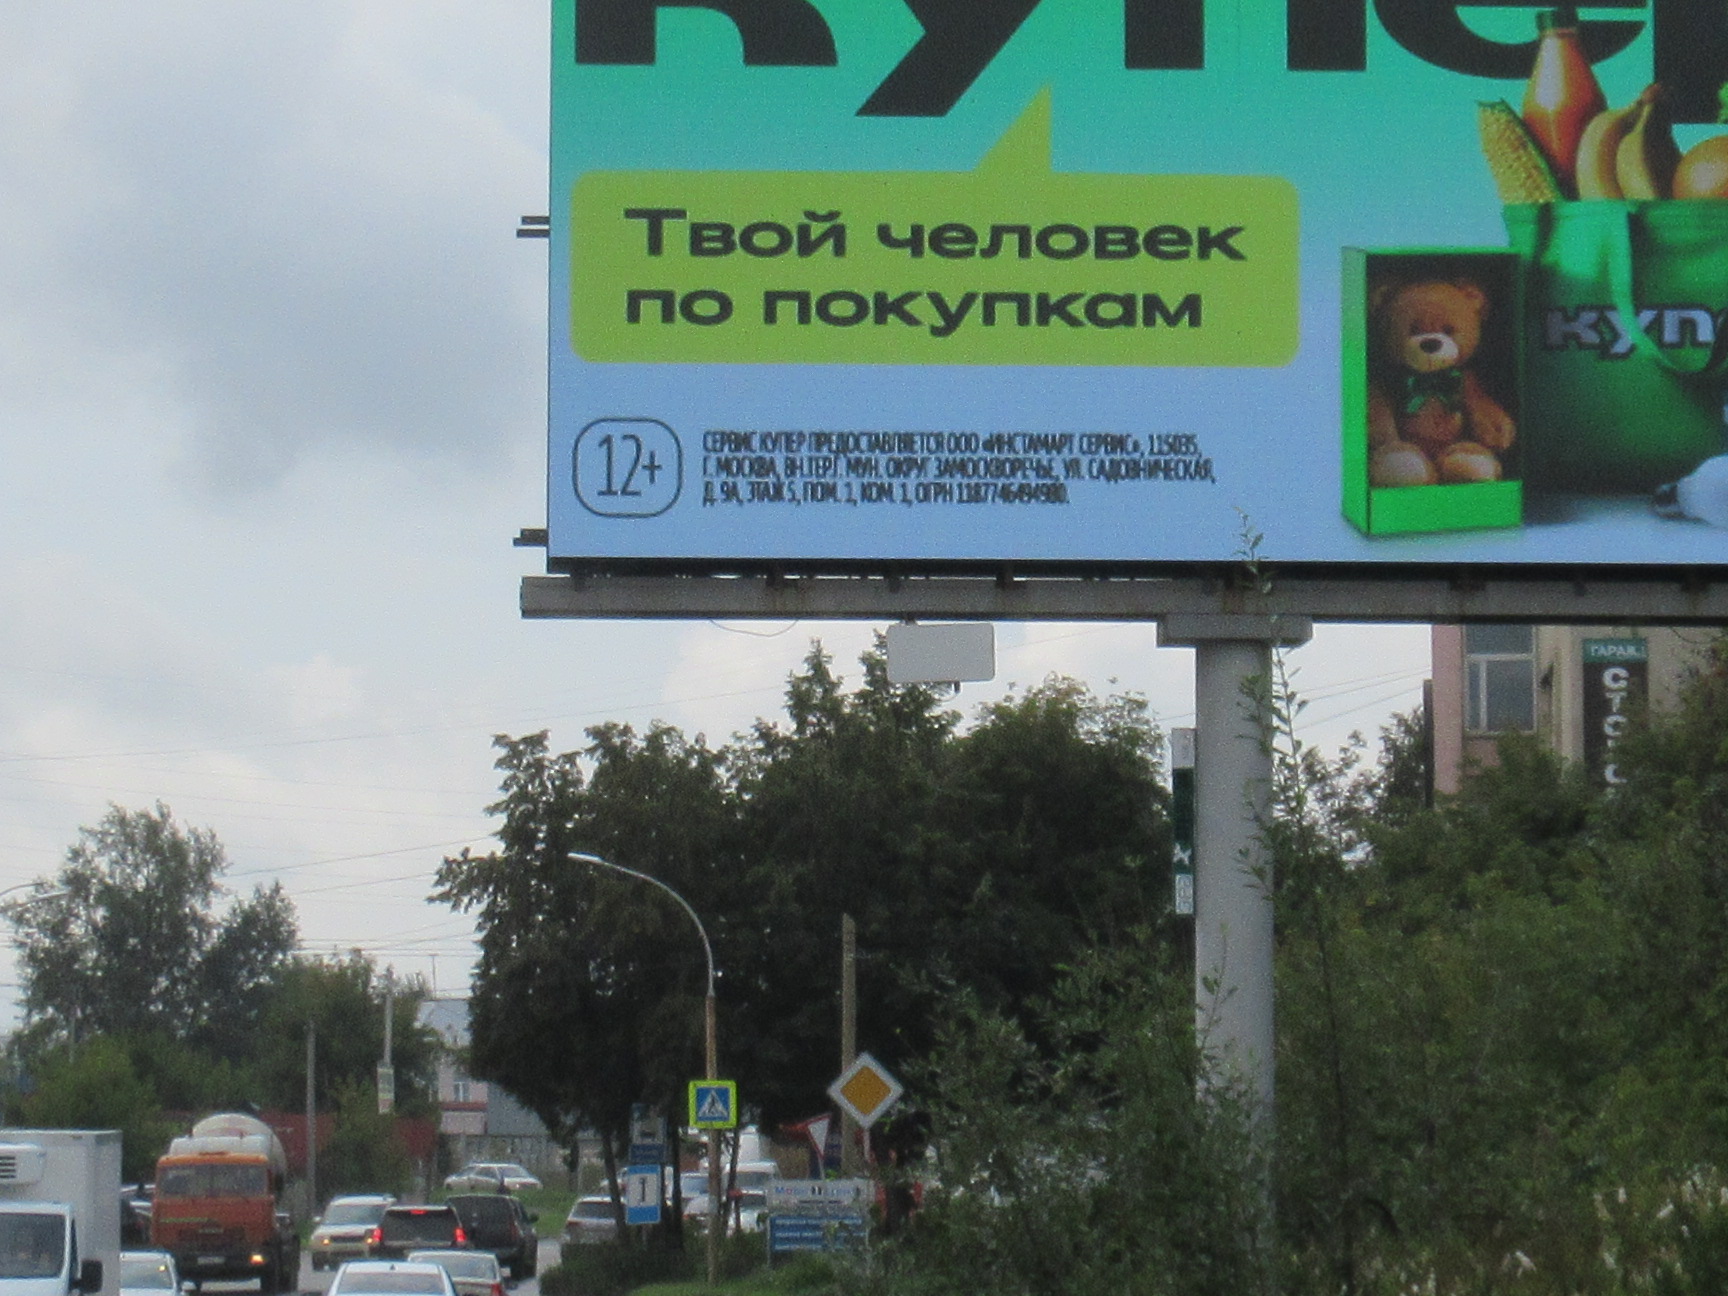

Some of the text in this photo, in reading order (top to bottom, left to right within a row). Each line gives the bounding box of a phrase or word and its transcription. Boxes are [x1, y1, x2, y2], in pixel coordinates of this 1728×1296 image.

[623, 206, 1248, 262] Твой человек
[625, 288, 1203, 338] по покупкам
[702, 430, 757, 453] СЕРВИС
[759, 431, 806, 453] КУПЕР
[808, 431, 945, 456] ПРЕДОСТАВЛЯЕТСЯ
[947, 432, 980, 454] ООО
[596, 433, 663, 497] 12+
[715, 455, 782, 482] МОСКВА,
[885, 456, 931, 479] ОКРУГ
[915, 482, 954, 504] ОГРН
